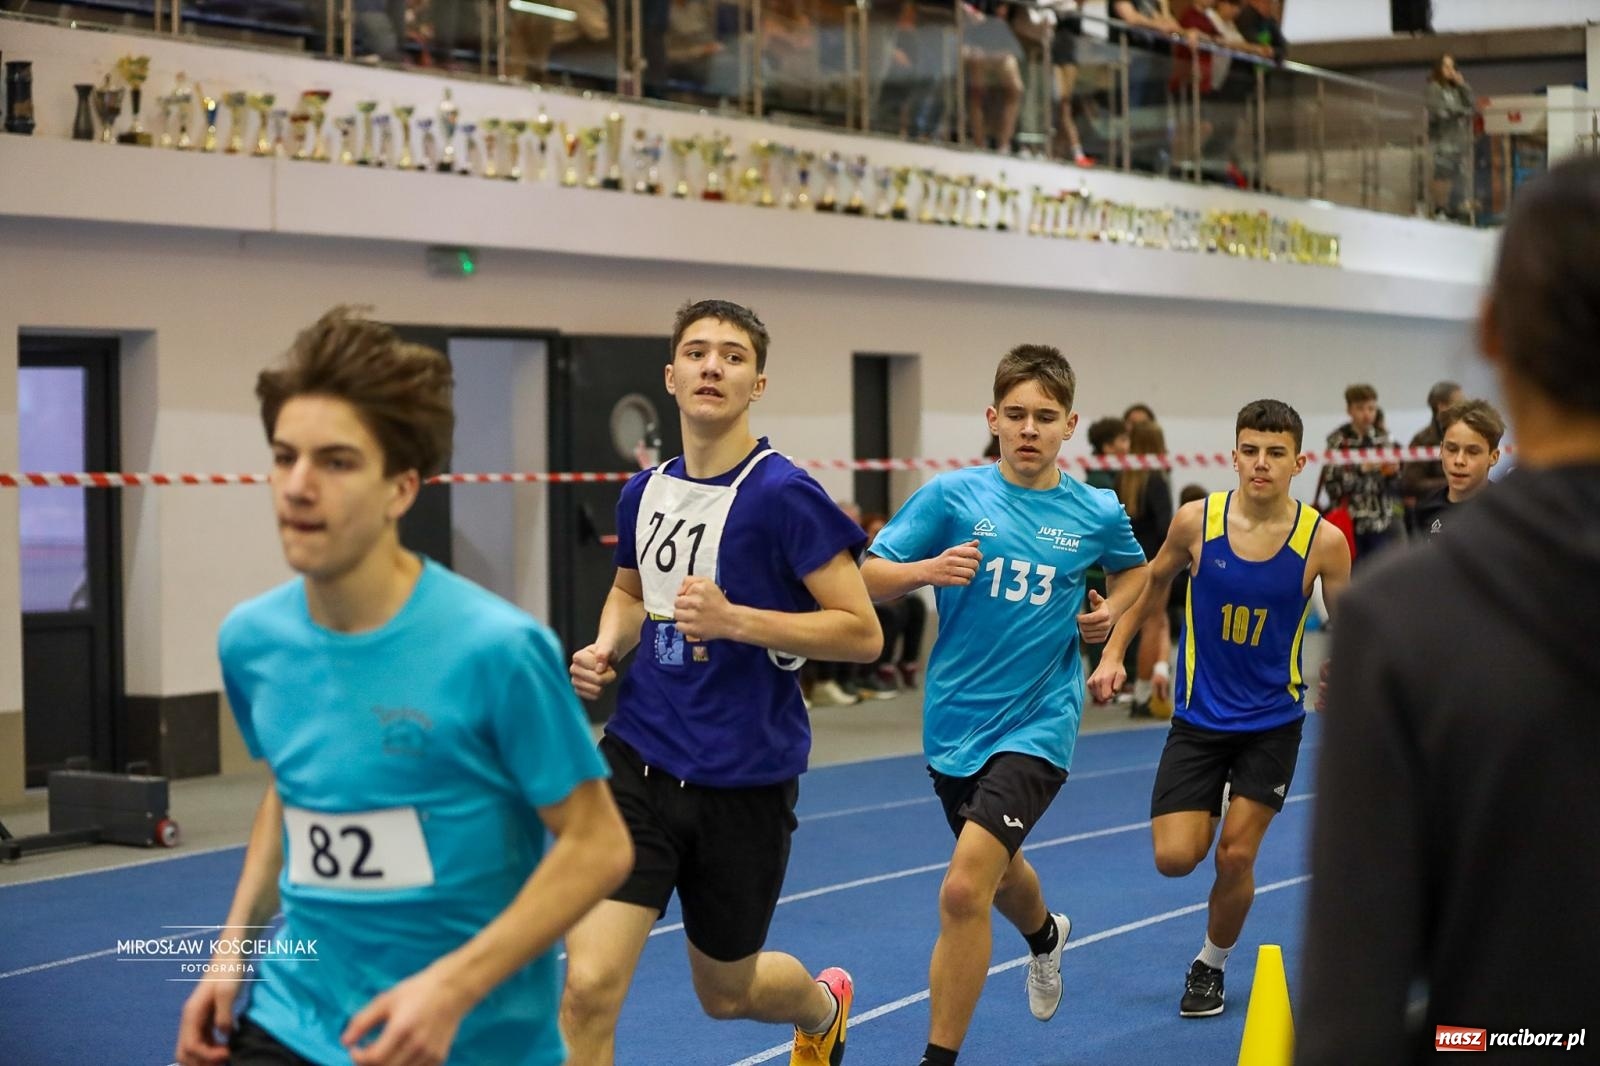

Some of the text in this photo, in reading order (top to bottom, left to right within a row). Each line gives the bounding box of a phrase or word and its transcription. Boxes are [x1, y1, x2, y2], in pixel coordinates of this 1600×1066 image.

[640, 511, 707, 576] 761
[1037, 526, 1064, 536] JUST
[1054, 537, 1080, 548] TEAM
[985, 556, 1057, 606] 133
[1221, 603, 1268, 646] 107
[309, 823, 384, 879] 82
